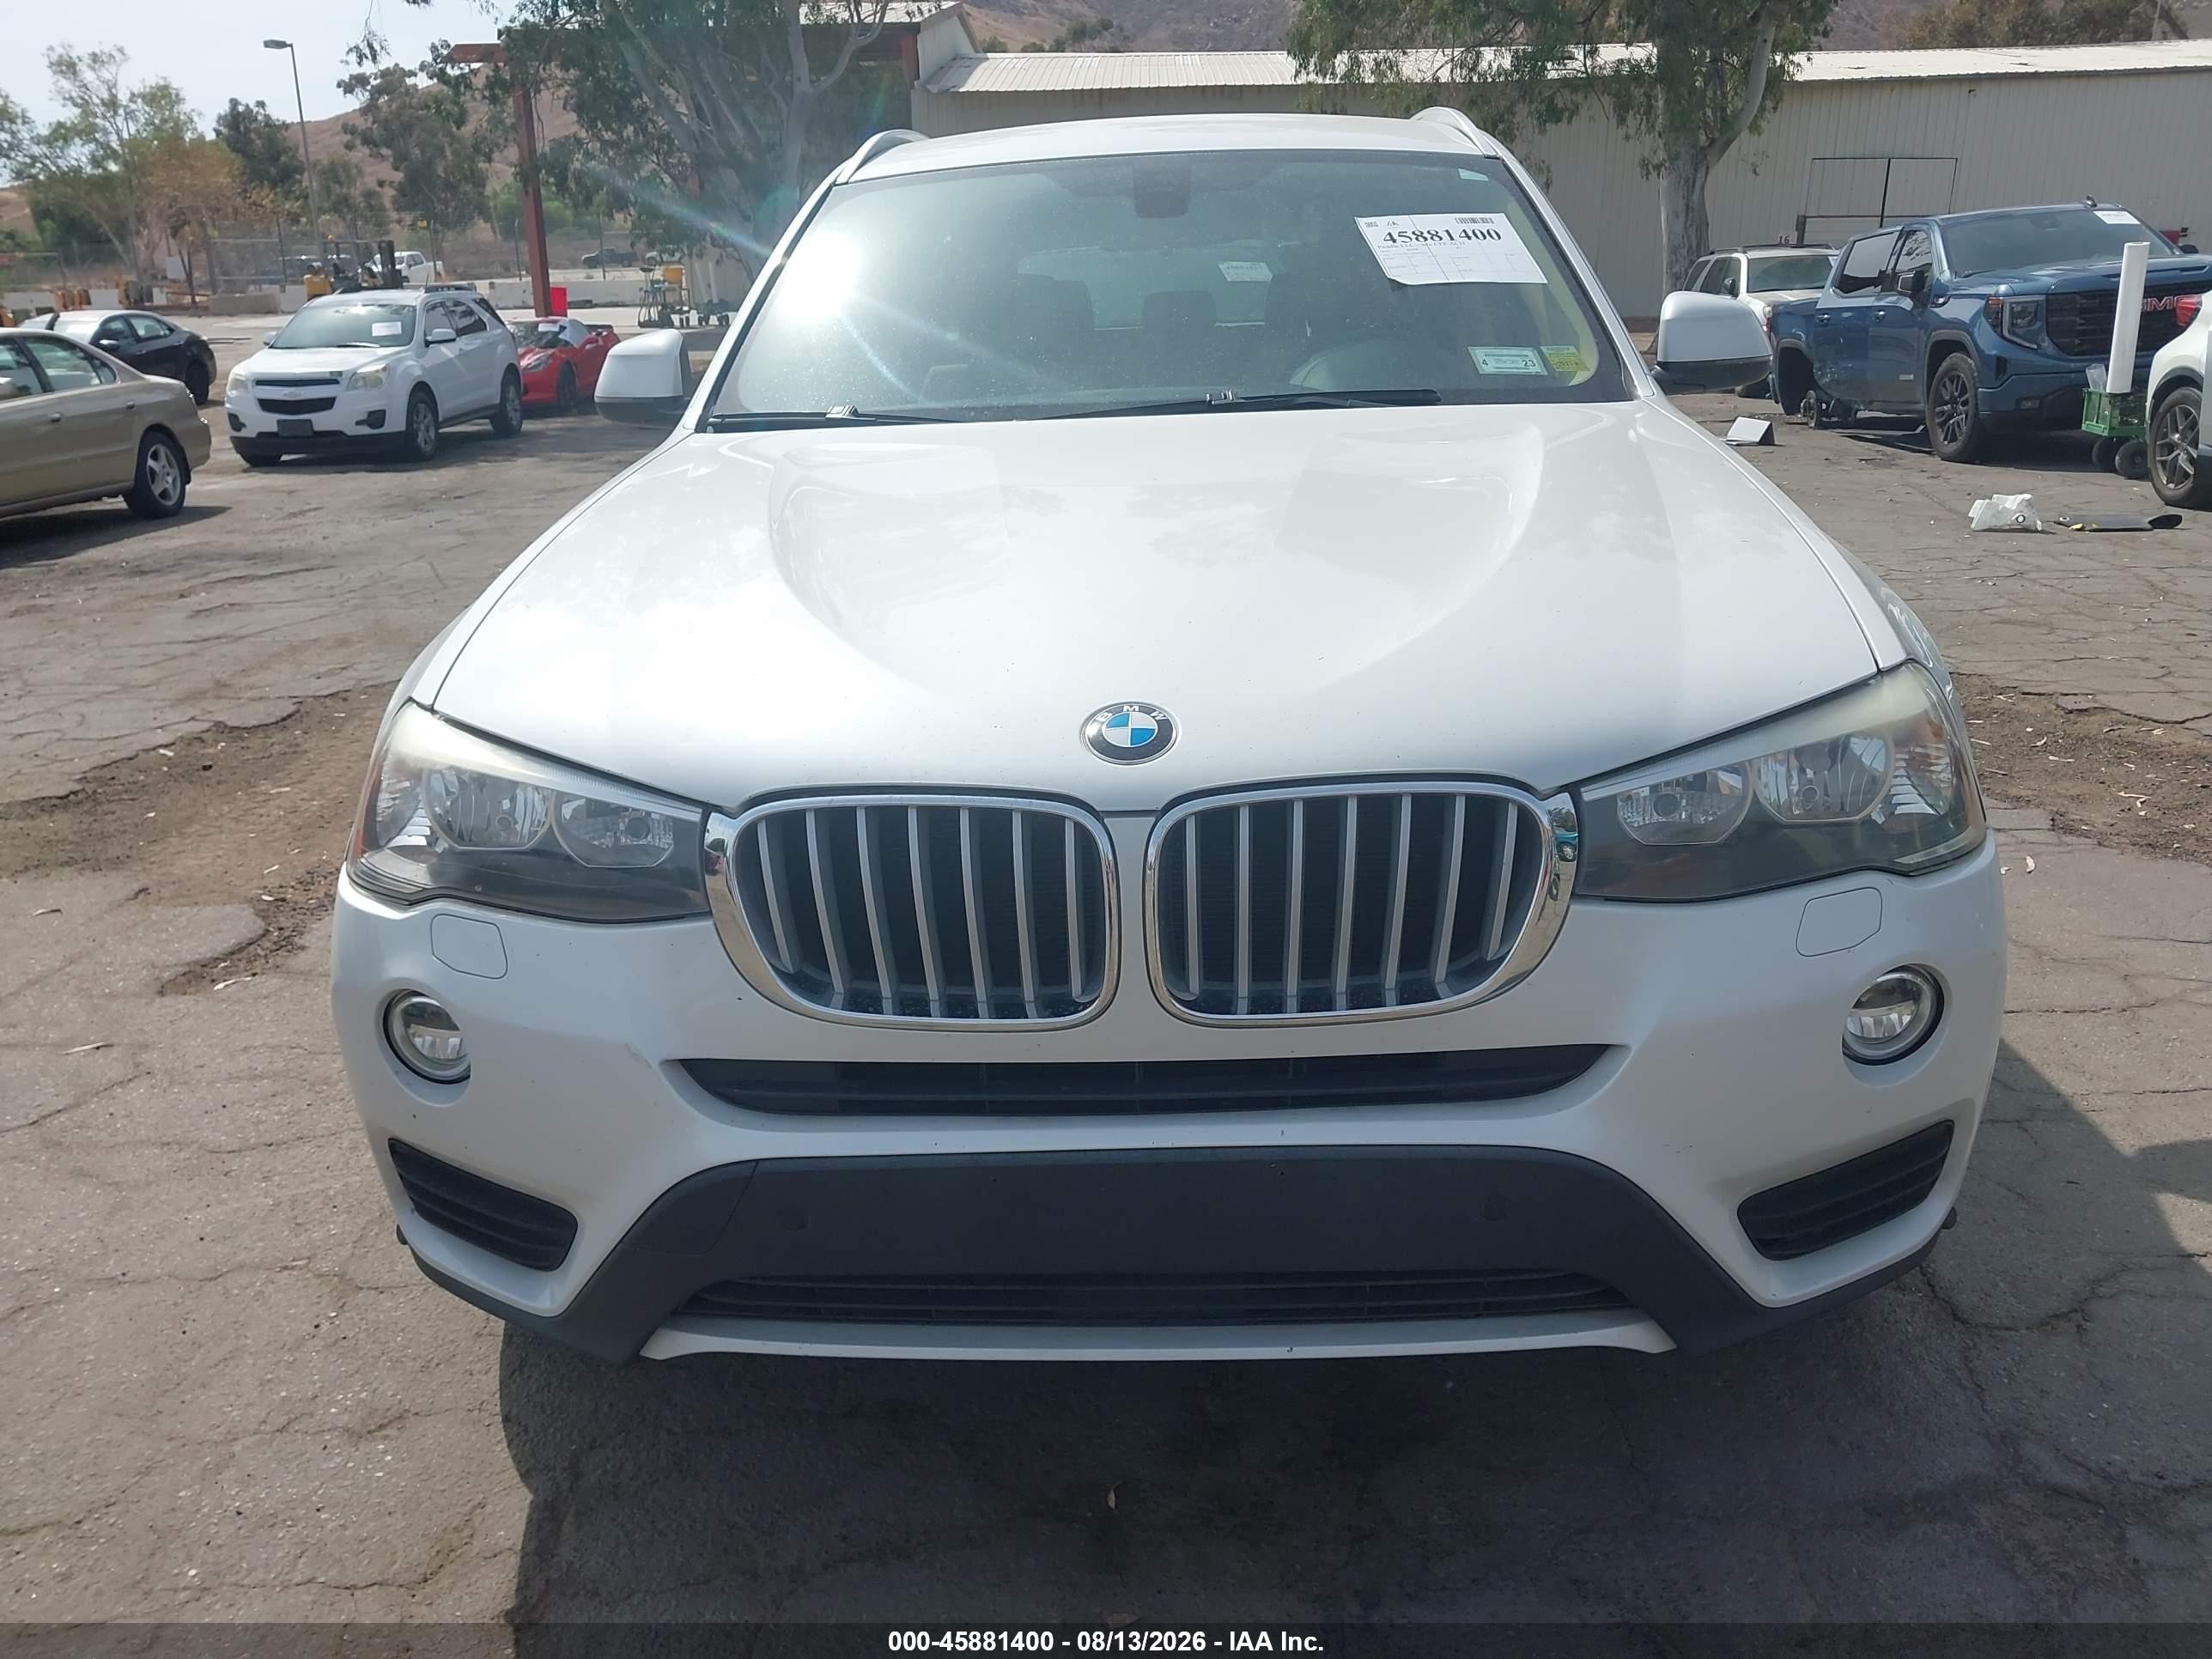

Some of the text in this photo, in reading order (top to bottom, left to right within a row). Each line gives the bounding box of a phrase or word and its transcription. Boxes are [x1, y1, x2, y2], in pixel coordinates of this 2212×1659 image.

[1383, 228, 1502, 244] 45881400
[1522, 359, 1536, 368] 23
[1096, 705, 1168, 721] BMW
